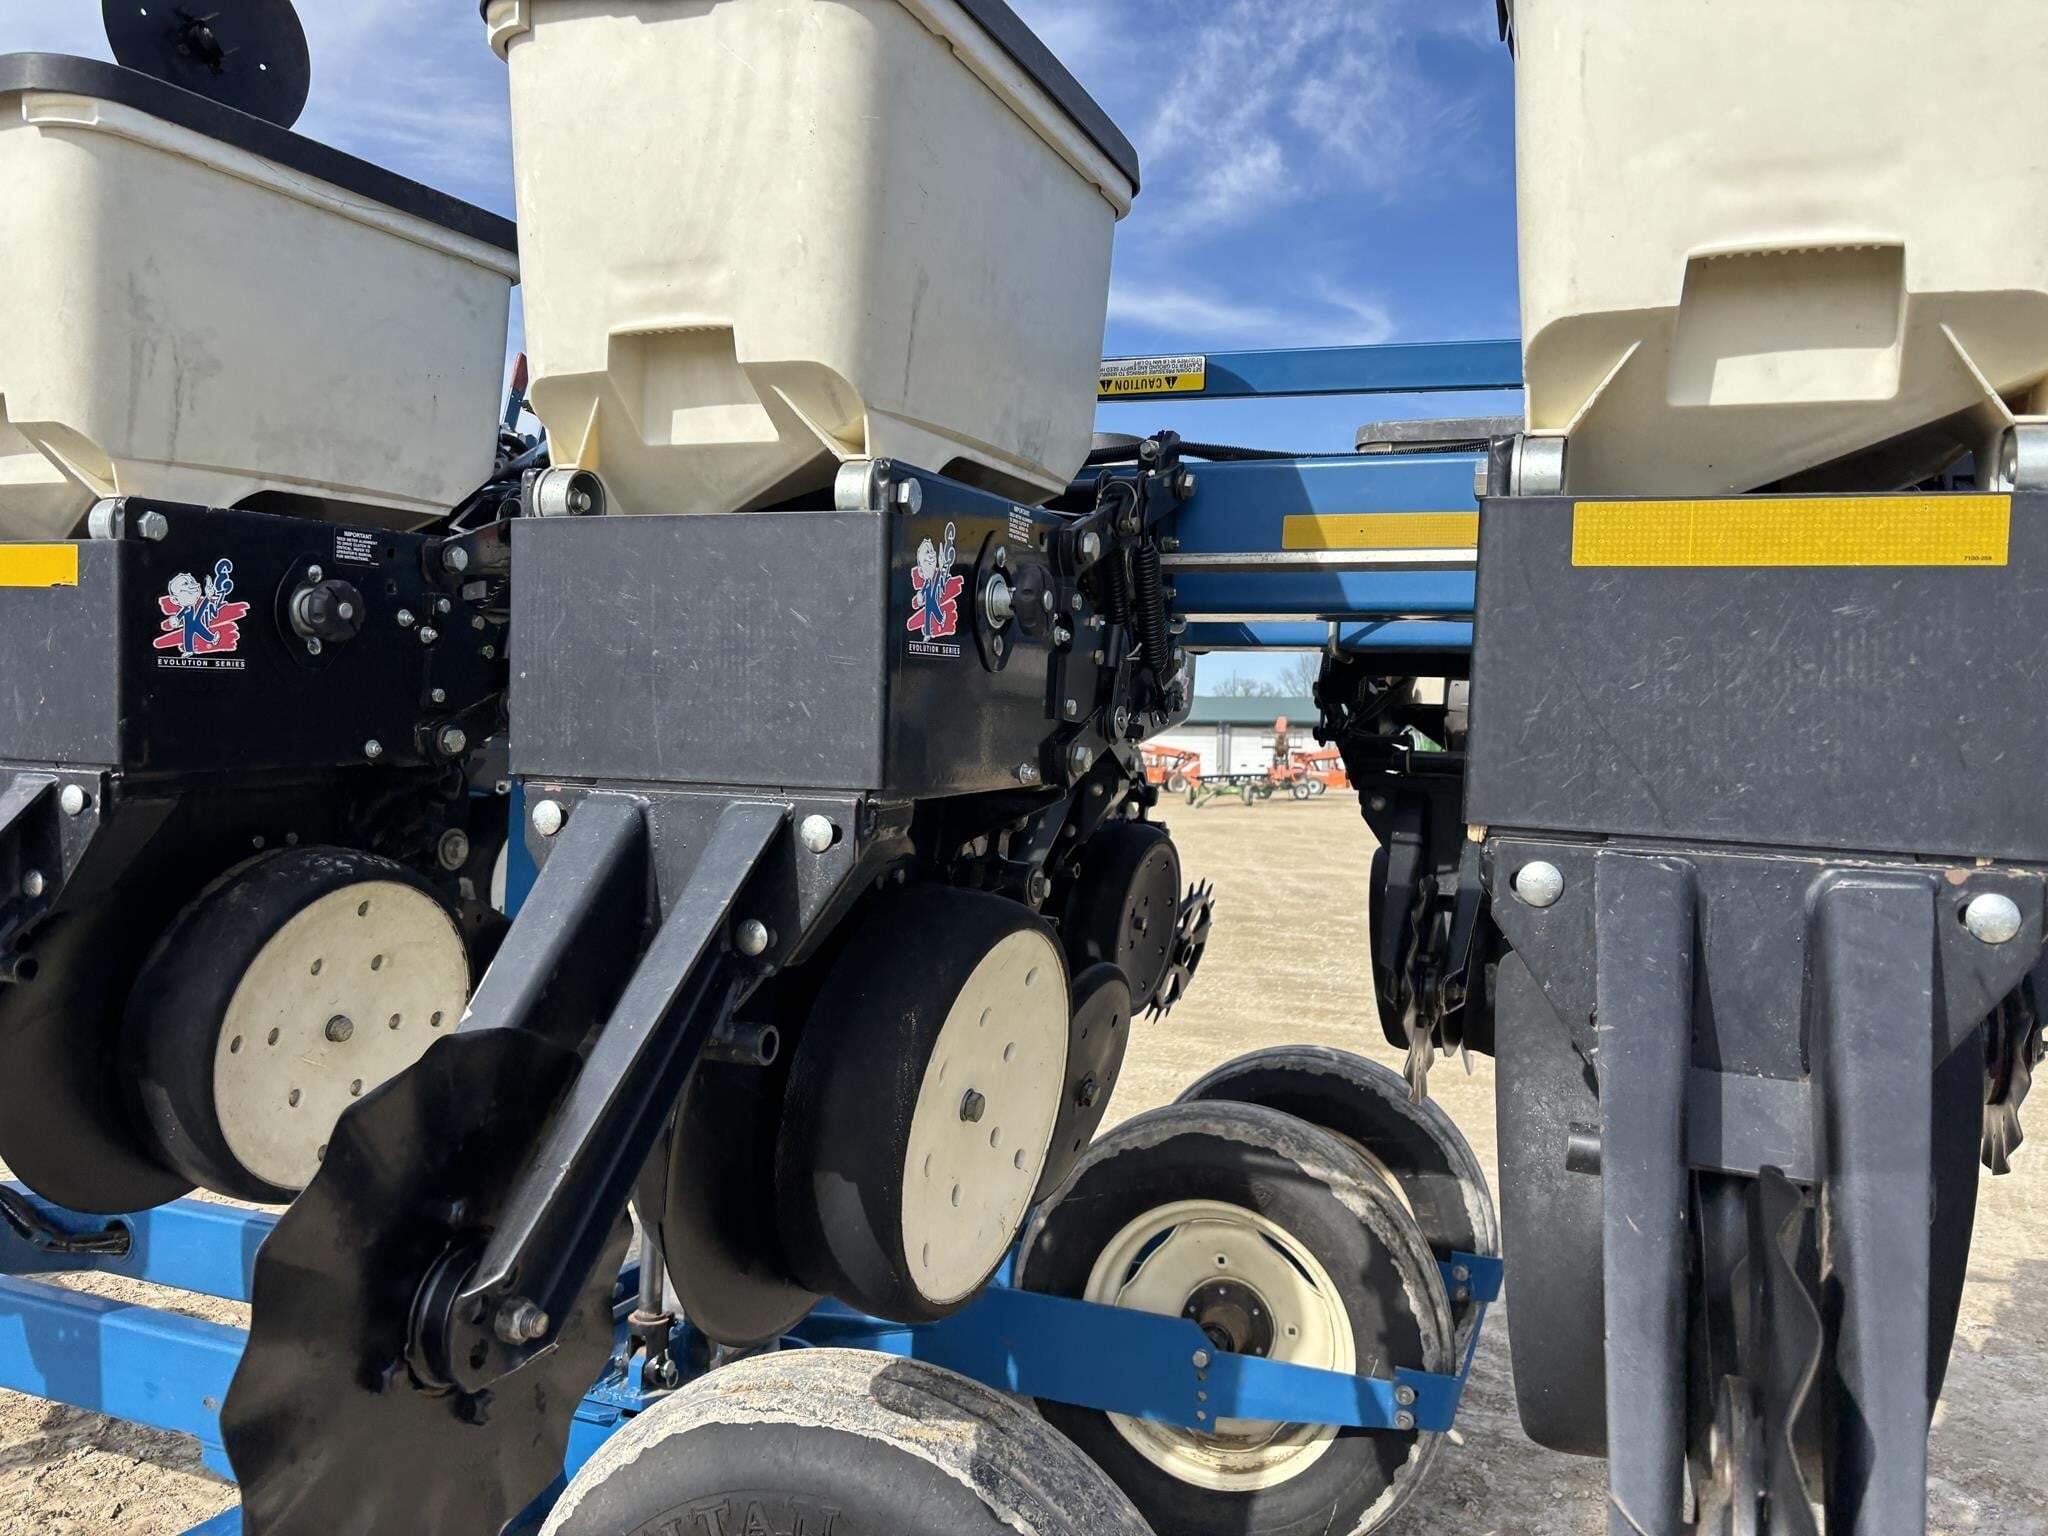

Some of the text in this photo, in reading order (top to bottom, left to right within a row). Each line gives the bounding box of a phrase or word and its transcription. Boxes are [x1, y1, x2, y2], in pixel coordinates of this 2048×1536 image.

[1115, 378, 1162, 390] CAUTION
[344, 531, 372, 539] IMPORTANT
[909, 643, 961, 654] EVOLUTION SERIES
[157, 658, 245, 668] EVOLUTION SERIES
